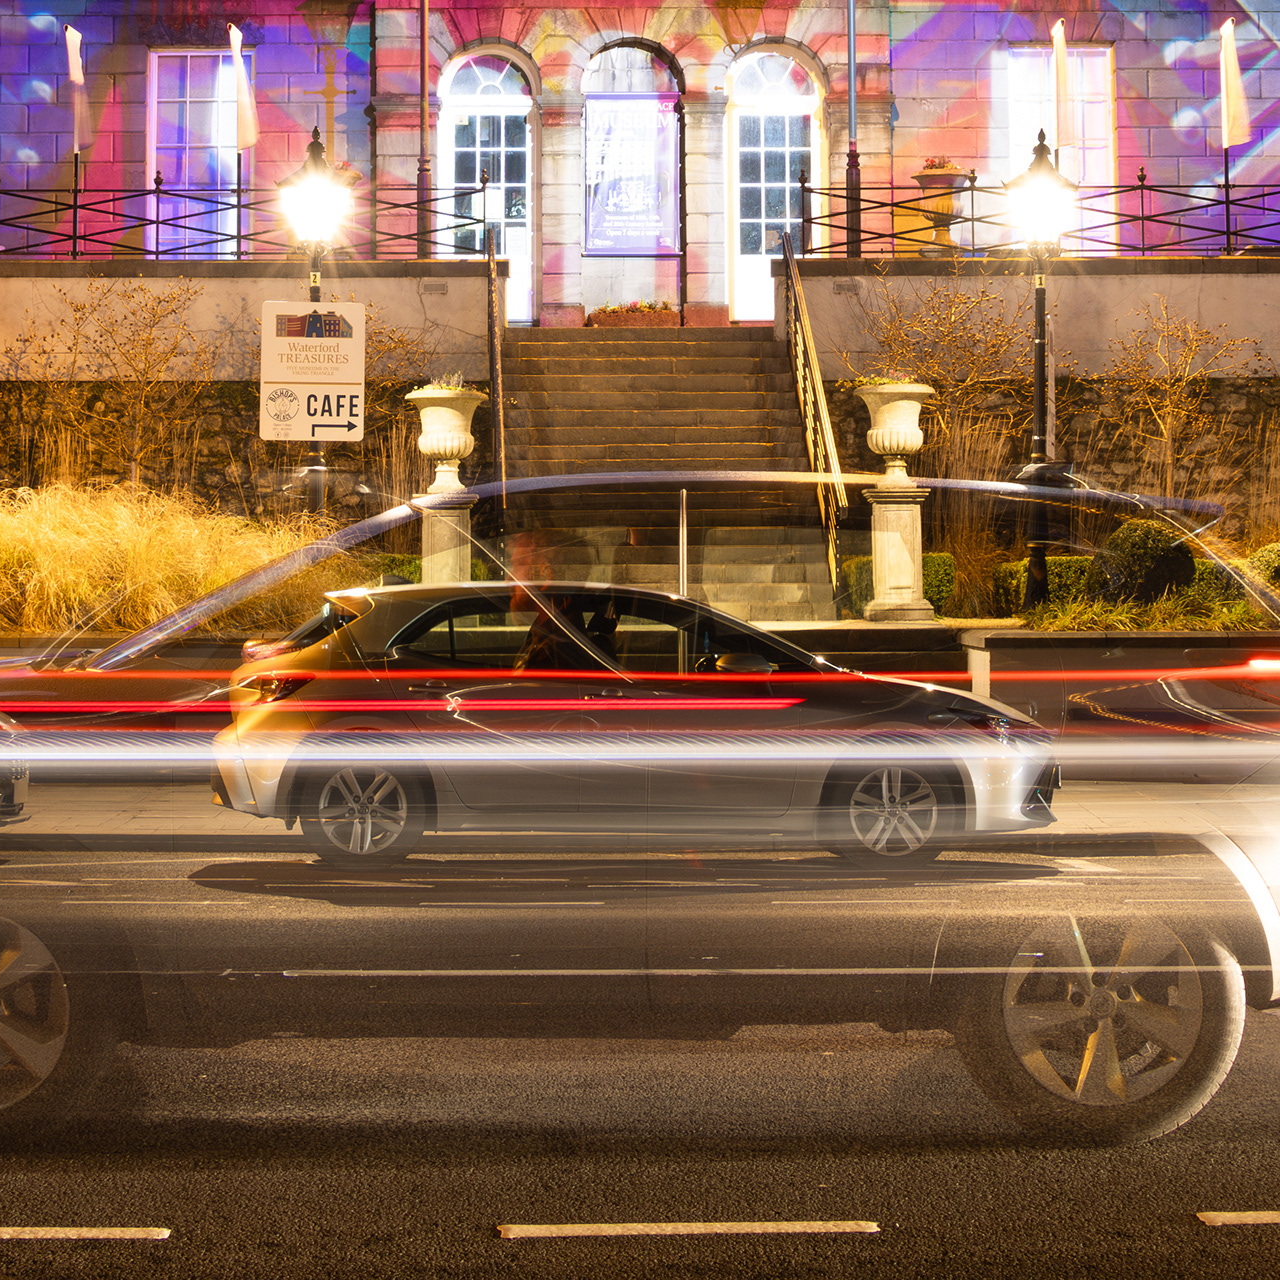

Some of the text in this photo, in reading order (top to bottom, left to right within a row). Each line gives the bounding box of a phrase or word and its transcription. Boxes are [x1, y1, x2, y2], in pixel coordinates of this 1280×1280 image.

[592, 111, 674, 129] MUSEUM
[605, 229, 622, 237] Open
[626, 229, 640, 237] days
[312, 273, 317, 284] 2
[1038, 276, 1043, 286] 1
[287, 342, 340, 353] Waterford
[277, 353, 349, 365] TREASURES
[306, 394, 359, 417] CAFE
